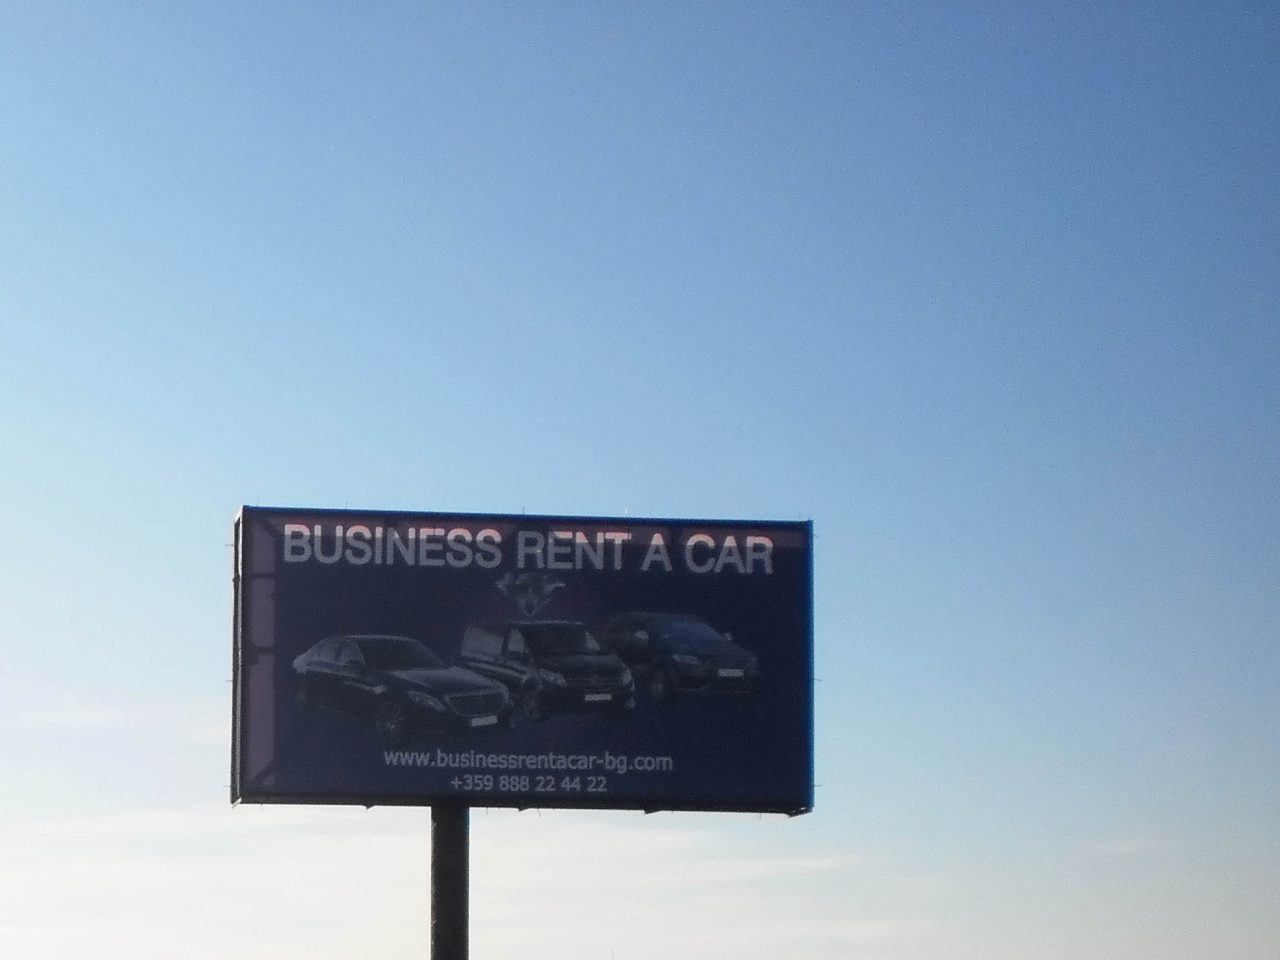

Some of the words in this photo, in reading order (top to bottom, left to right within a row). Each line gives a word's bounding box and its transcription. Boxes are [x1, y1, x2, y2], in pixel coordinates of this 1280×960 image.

[283, 524, 502, 569] BUSINESS
[518, 531, 631, 570] RENT
[641, 533, 672, 571] A
[685, 534, 774, 575] CAR
[384, 748, 673, 773] www.businessrentacar-bg.com
[450, 773, 494, 791] +359
[499, 774, 530, 792] 888
[536, 775, 557, 792] 22
[561, 775, 582, 792] 44
[586, 775, 607, 792] 22
